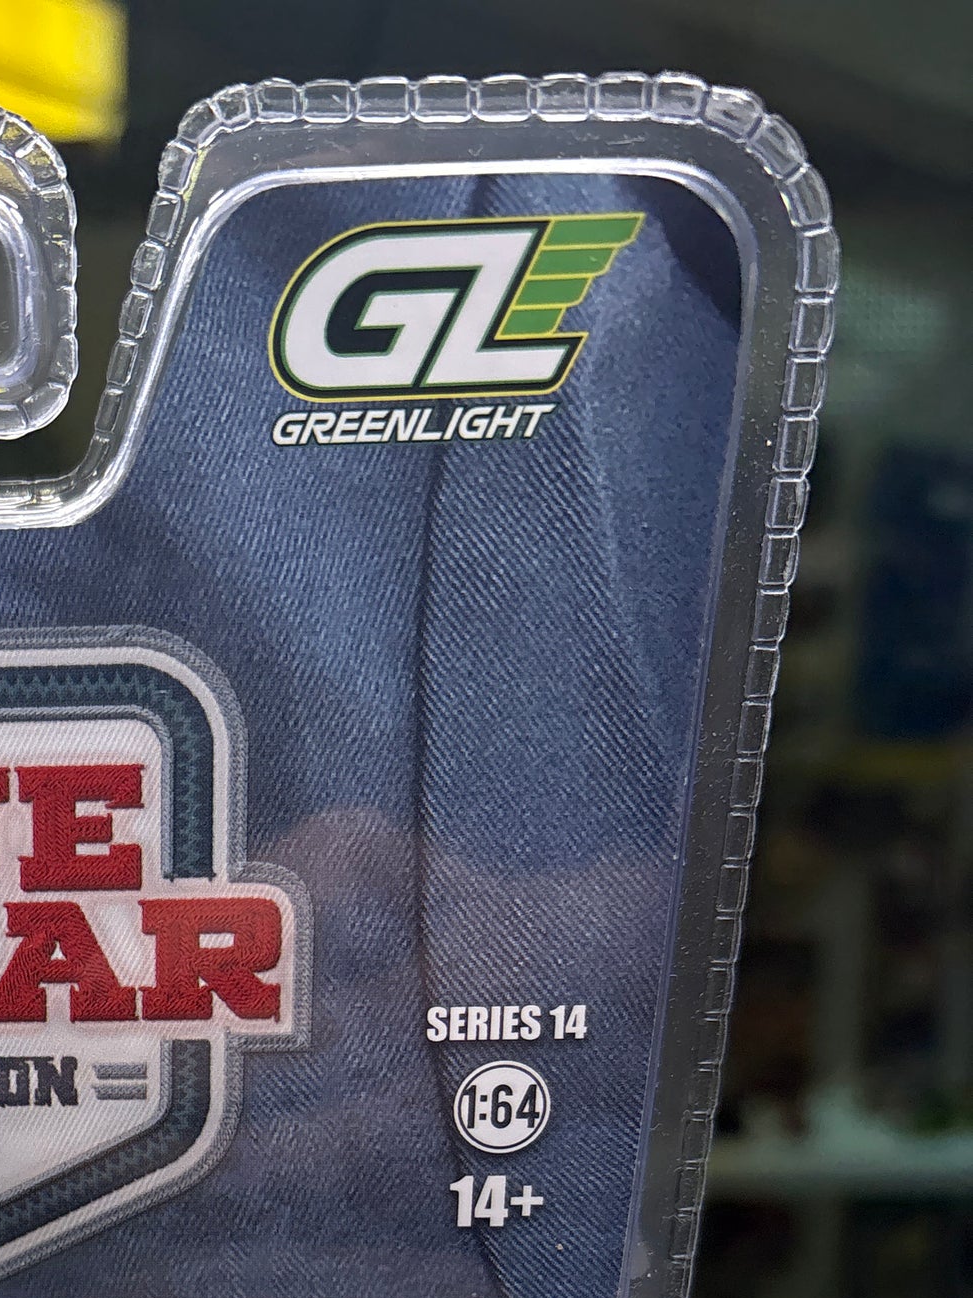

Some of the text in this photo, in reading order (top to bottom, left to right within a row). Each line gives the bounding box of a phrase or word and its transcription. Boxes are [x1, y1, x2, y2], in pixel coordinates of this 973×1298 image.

[277, 222, 583, 396] GL
[272, 403, 559, 446] GREENLIGHT
[426, 1003, 588, 1043] SERIES 14
[463, 1083, 540, 1129] 1:64
[449, 1174, 544, 1228] 14+
